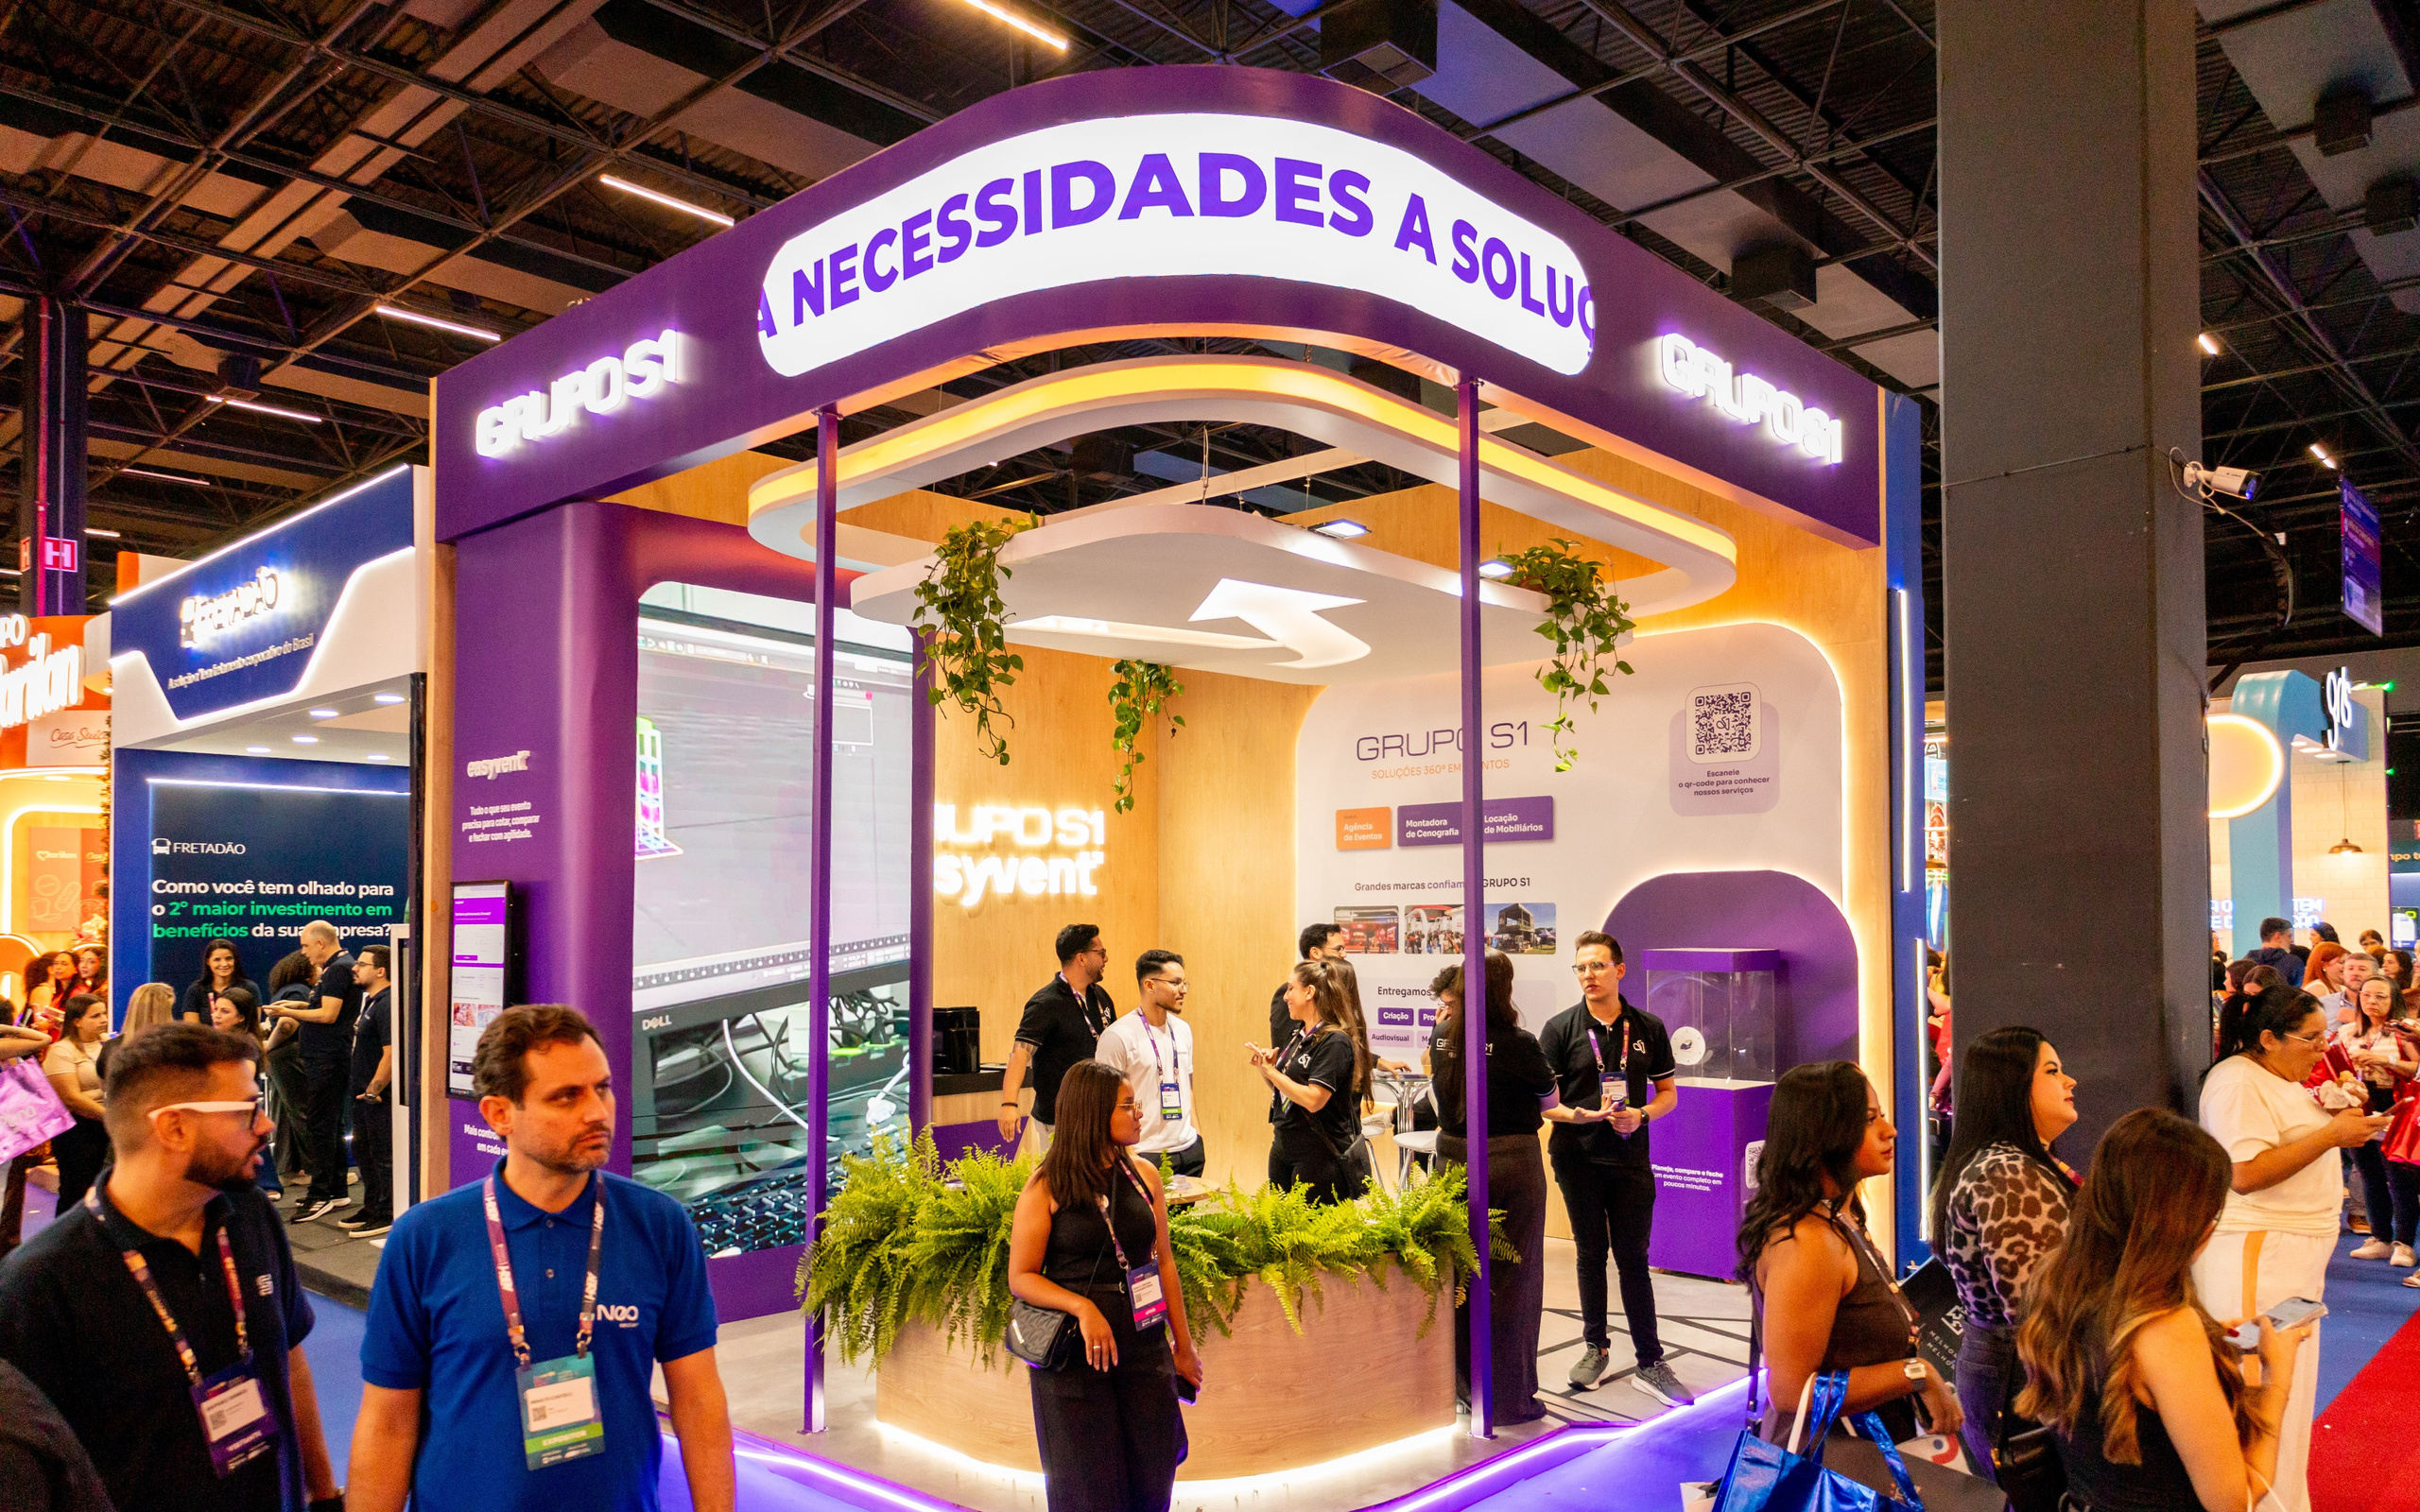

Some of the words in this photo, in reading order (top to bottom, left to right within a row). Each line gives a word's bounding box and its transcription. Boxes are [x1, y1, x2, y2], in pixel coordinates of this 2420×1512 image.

[792, 152, 1374, 328] NECESSIDADES
[1394, 193, 1438, 266] A
[292, 633, 314, 652] Brasil
[1491, 721, 1528, 748] S1
[1372, 765, 1422, 780] SOLUÇÕES
[1447, 763, 1461, 773] EM
[1481, 759, 1510, 770] NTOS
[1706, 769, 1739, 778] Escaneie
[1685, 780, 1715, 789] qr-code
[1716, 780, 1733, 788] para
[1734, 776, 1771, 785] conhecer
[1694, 788, 1720, 797] nossos
[1721, 786, 1754, 796] serviços
[470, 805, 484, 816] Tudo
[489, 805, 500, 816] que
[500, 804, 510, 813] seu
[511, 800, 531, 812] evento
[462, 818, 482, 833] precisa
[482, 819, 495, 831] para
[511, 815, 541, 827] comparar
[1406, 818, 1447, 828] Montadora
[1484, 814, 1518, 825] Locação
[1057, 809, 1105, 846] S1
[1343, 822, 1373, 833] Agência
[1406, 830, 1415, 838] de
[1416, 828, 1460, 839] Cenografia
[1484, 826, 1495, 834] de
[1495, 822, 1544, 833] Mobiliários
[473, 832, 491, 843] fechar
[491, 832, 504, 841] com
[1354, 833, 1382, 841] Eventos
[173, 841, 246, 855] FRETADÃO
[151, 879, 209, 894] Como
[212, 879, 255, 894] você
[258, 881, 294, 895] tem
[297, 881, 355, 896] olhado
[358, 885, 394, 899] para
[1355, 881, 1392, 892] Grandes
[1392, 881, 1426, 891] marcas
[1426, 879, 1465, 890] confiam
[1481, 878, 1518, 888] GRUPO
[1520, 877, 1530, 886] S1
[151, 904, 165, 917] o
[193, 901, 246, 916] maior
[251, 901, 363, 917] investimento
[366, 904, 392, 917] em
[153, 923, 249, 938] benefícios
[251, 923, 274, 937] da
[337, 923, 391, 941] mpresa?
[1377, 986, 1432, 998] Entregamos
[642, 1014, 672, 1031] DELL
[1383, 1011, 1409, 1022] Criação
[1371, 1033, 1409, 1042] Audiovisual
[464, 1124, 477, 1136] Mais
[476, 1143, 487, 1152] em
[487, 1144, 501, 1155] cada
[1683, 1176, 1711, 1185] completo
